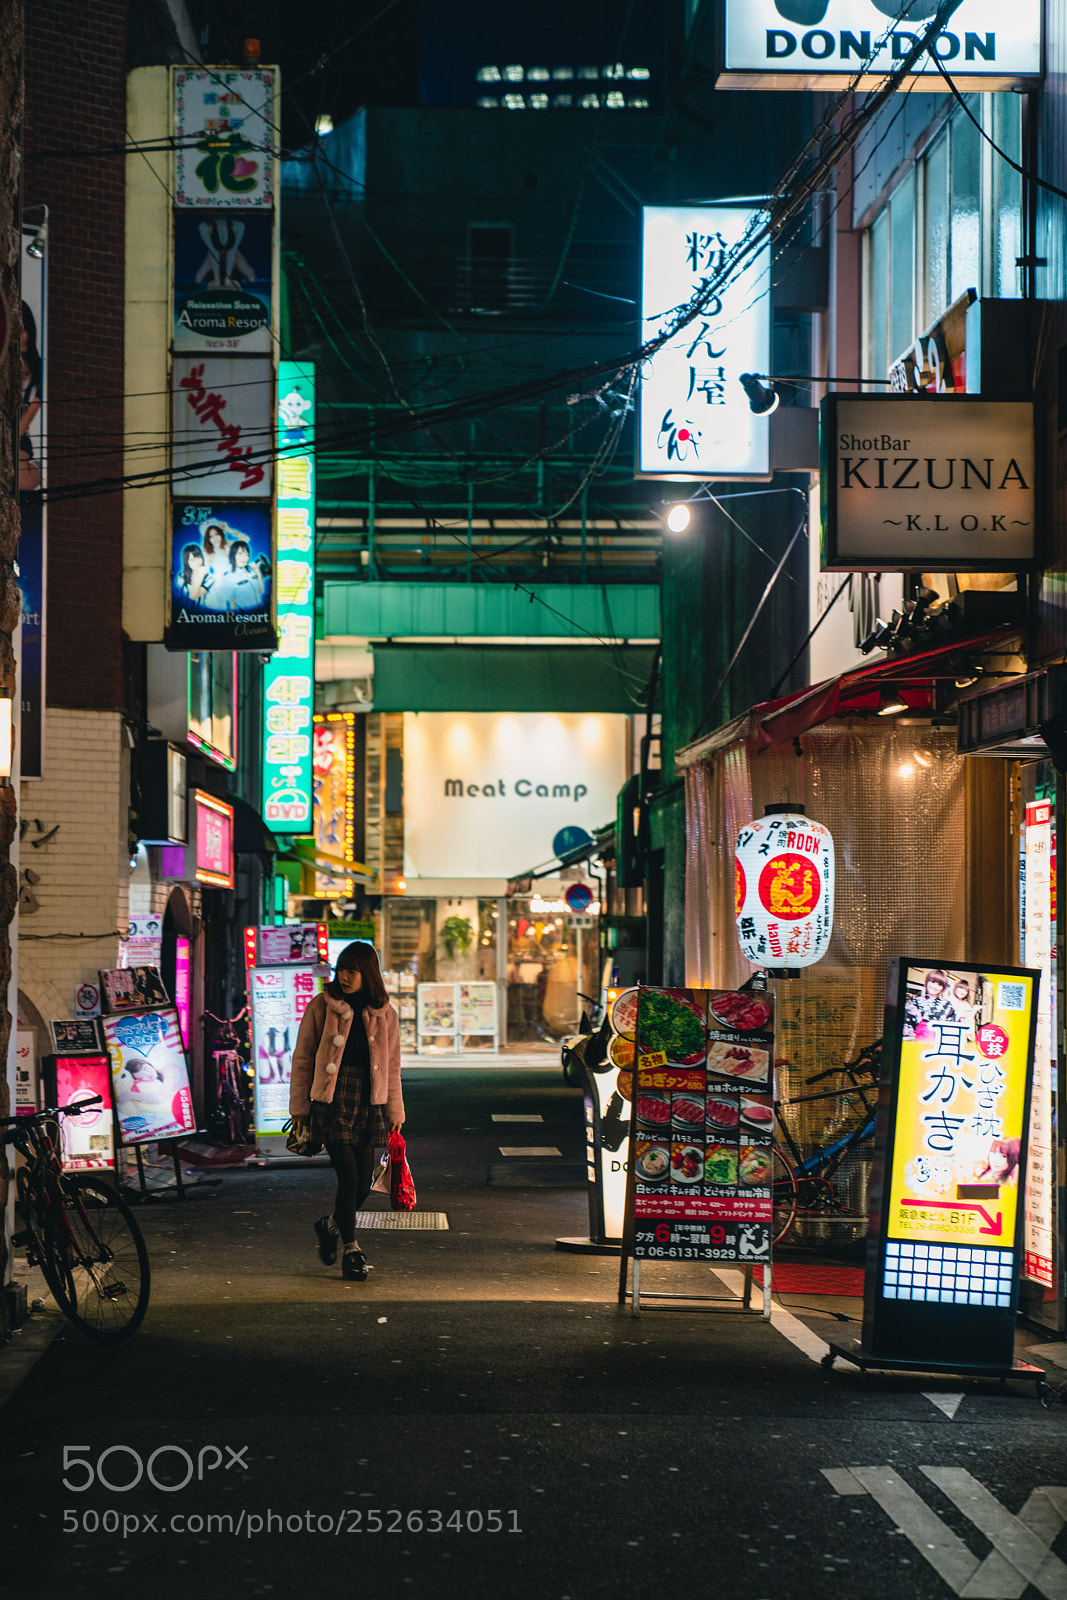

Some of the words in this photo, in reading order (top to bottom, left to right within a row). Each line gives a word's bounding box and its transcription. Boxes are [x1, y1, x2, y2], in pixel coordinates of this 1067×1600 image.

[766, 29, 996, 61] DON-DON
[195, 133, 258, 193] 花
[685, 232, 728, 406] 粉もん屋
[840, 434, 911, 451] ShotBar
[840, 457, 1031, 490] KIZUNA
[181, 505, 212, 525] 3F
[269, 680, 307, 701] 4F
[269, 709, 306, 731] 3F
[269, 738, 306, 760] 2F
[444, 779, 506, 797] Meat
[514, 779, 588, 802] Camp
[267, 804, 306, 819] DVD
[787, 831, 820, 855] ROCK
[767, 923, 784, 957] Happy
[641, 1053, 663, 1068] 名物
[638, 1072, 688, 1088] ねぎタン
[922, 1024, 975, 1152] 耳かき
[971, 1063, 1003, 1138] ひざ枕
[636, 1130, 659, 1141] カルビ
[672, 1134, 692, 1143] ハラミ
[706, 1135, 725, 1144] ロース
[950, 1211, 976, 1225] B1F
[648, 1246, 736, 1259] 06-6131-3929
